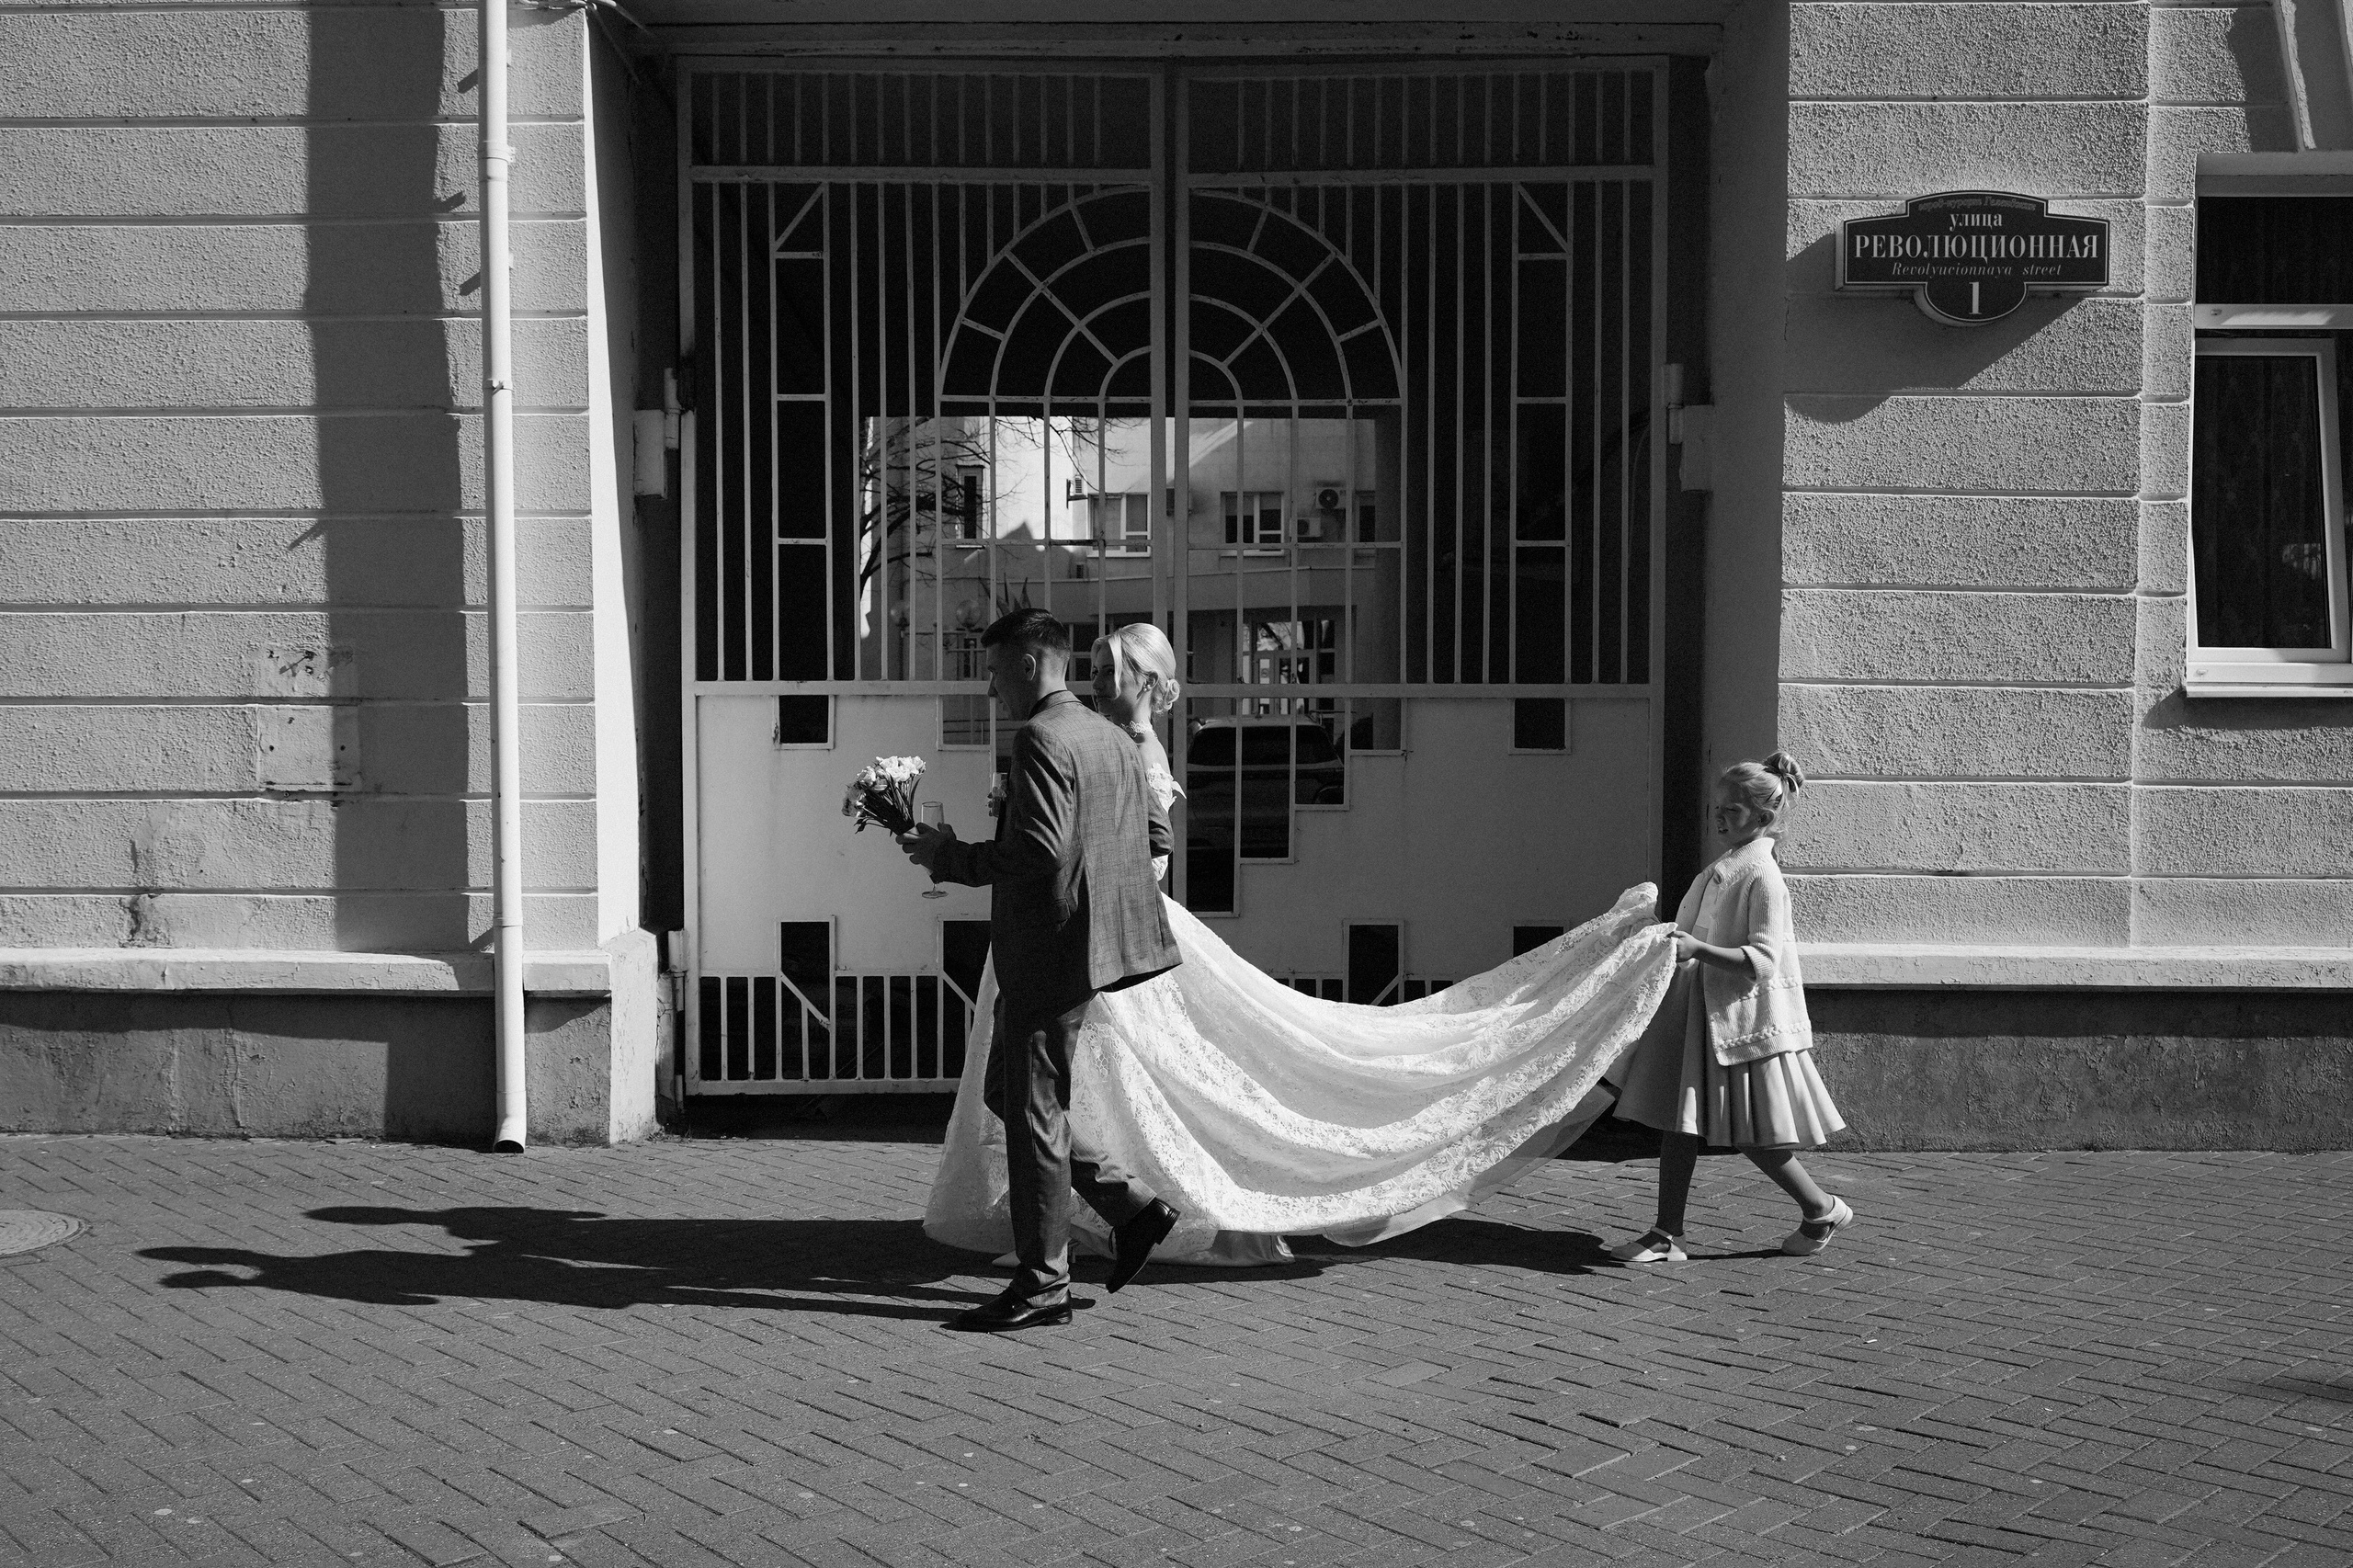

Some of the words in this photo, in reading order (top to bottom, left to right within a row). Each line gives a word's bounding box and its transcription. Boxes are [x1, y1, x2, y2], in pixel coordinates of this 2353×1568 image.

[1949, 213, 2003, 232] улица
[1855, 234, 2099, 264] РЕВОЛЮЦИОННАЯ
[1892, 262, 2013, 279] Revolyucionnaya
[2022, 263, 2062, 277] street
[1969, 281, 1983, 315] 1
